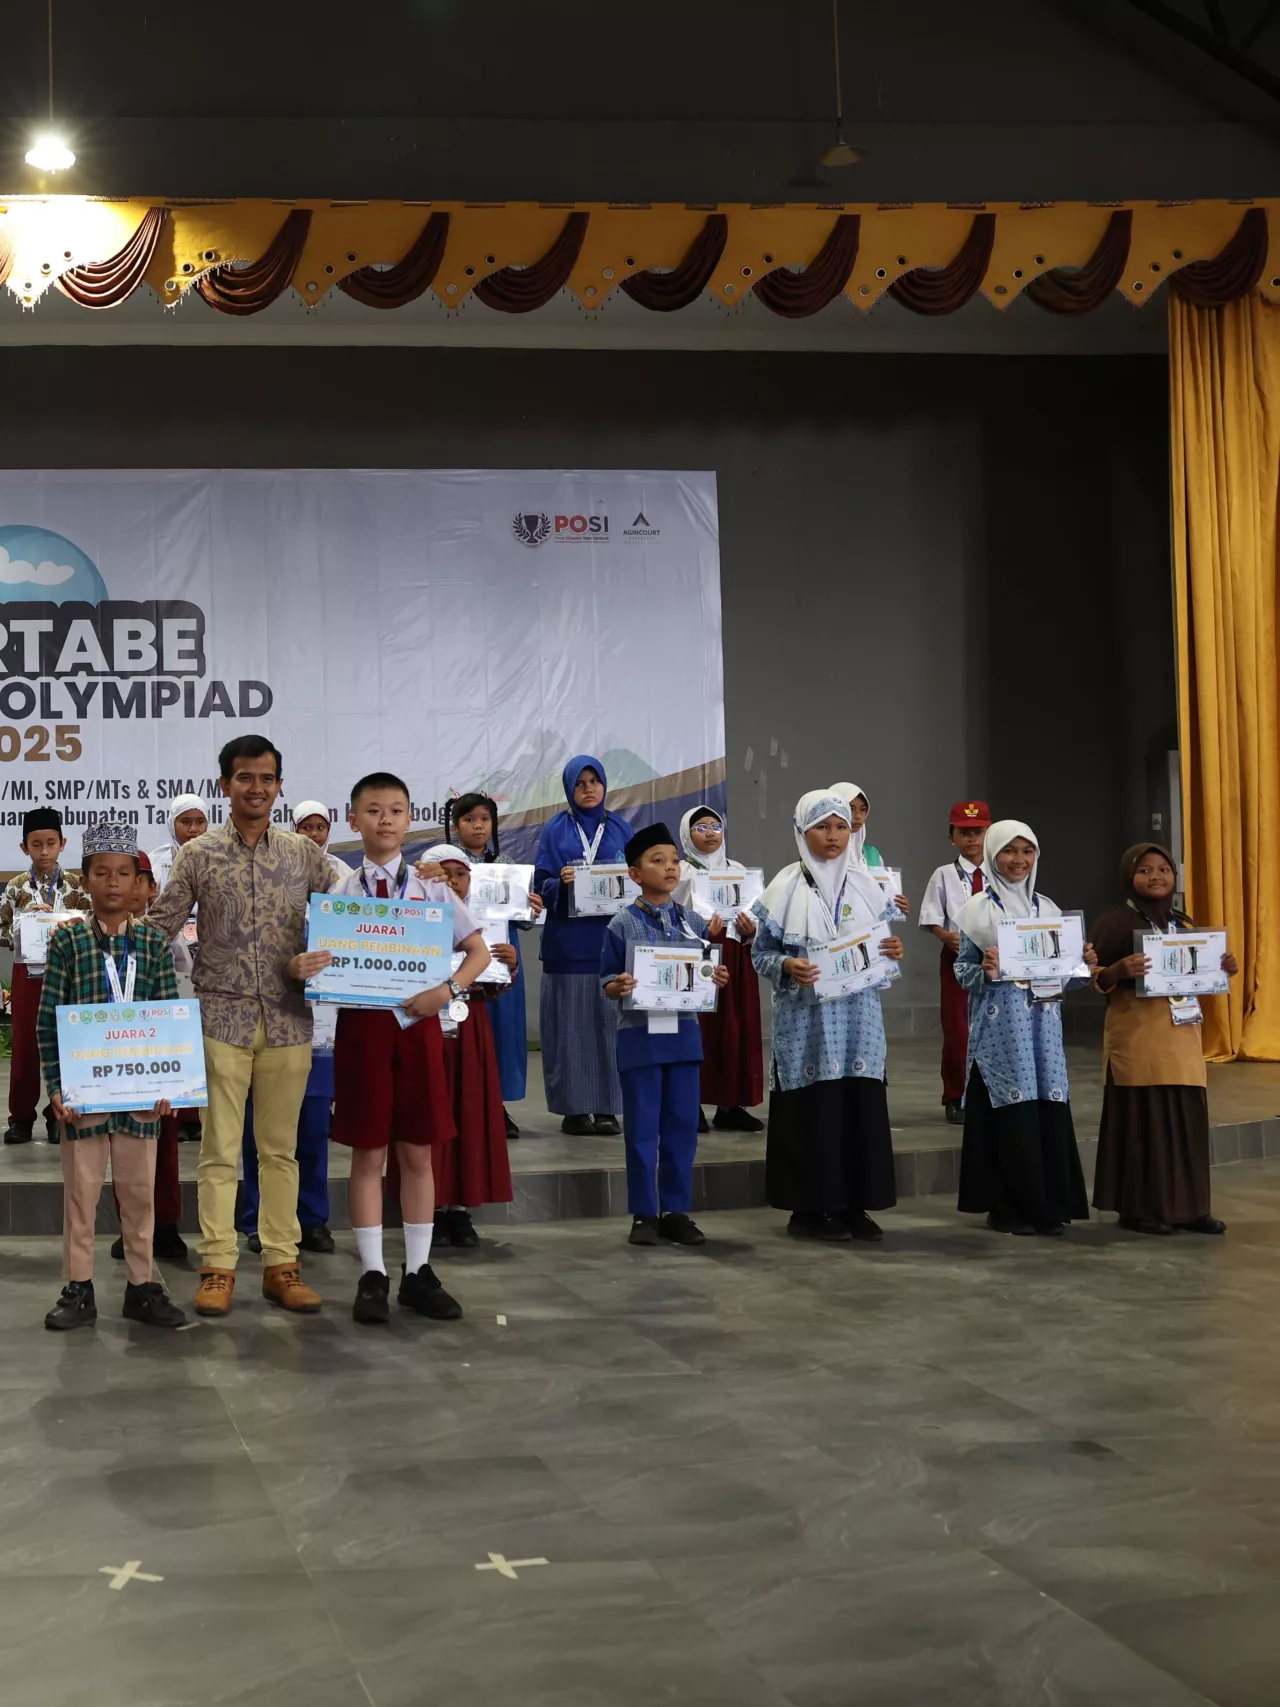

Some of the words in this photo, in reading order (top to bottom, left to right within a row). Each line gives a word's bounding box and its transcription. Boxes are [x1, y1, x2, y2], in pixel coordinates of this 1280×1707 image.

[554, 515, 608, 533] POSI
[45, 779, 130, 800] SMP/MTs
[137, 779, 150, 799] &
[404, 908, 424, 916] POSI
[355, 923, 398, 936] JUARA
[400, 926, 406, 936] 1
[318, 938, 358, 950] UANG
[361, 942, 442, 957] PEMBINAAN
[331, 956, 351, 968] RP
[353, 957, 427, 973] 1.000.000
[105, 1029, 147, 1040] JUARA
[149, 1027, 156, 1038] 2
[71, 1047, 111, 1060] UANG
[114, 1043, 194, 1058] PEMBINAAN
[92, 1065, 113, 1078] RP
[115, 1060, 182, 1077] 750.000
